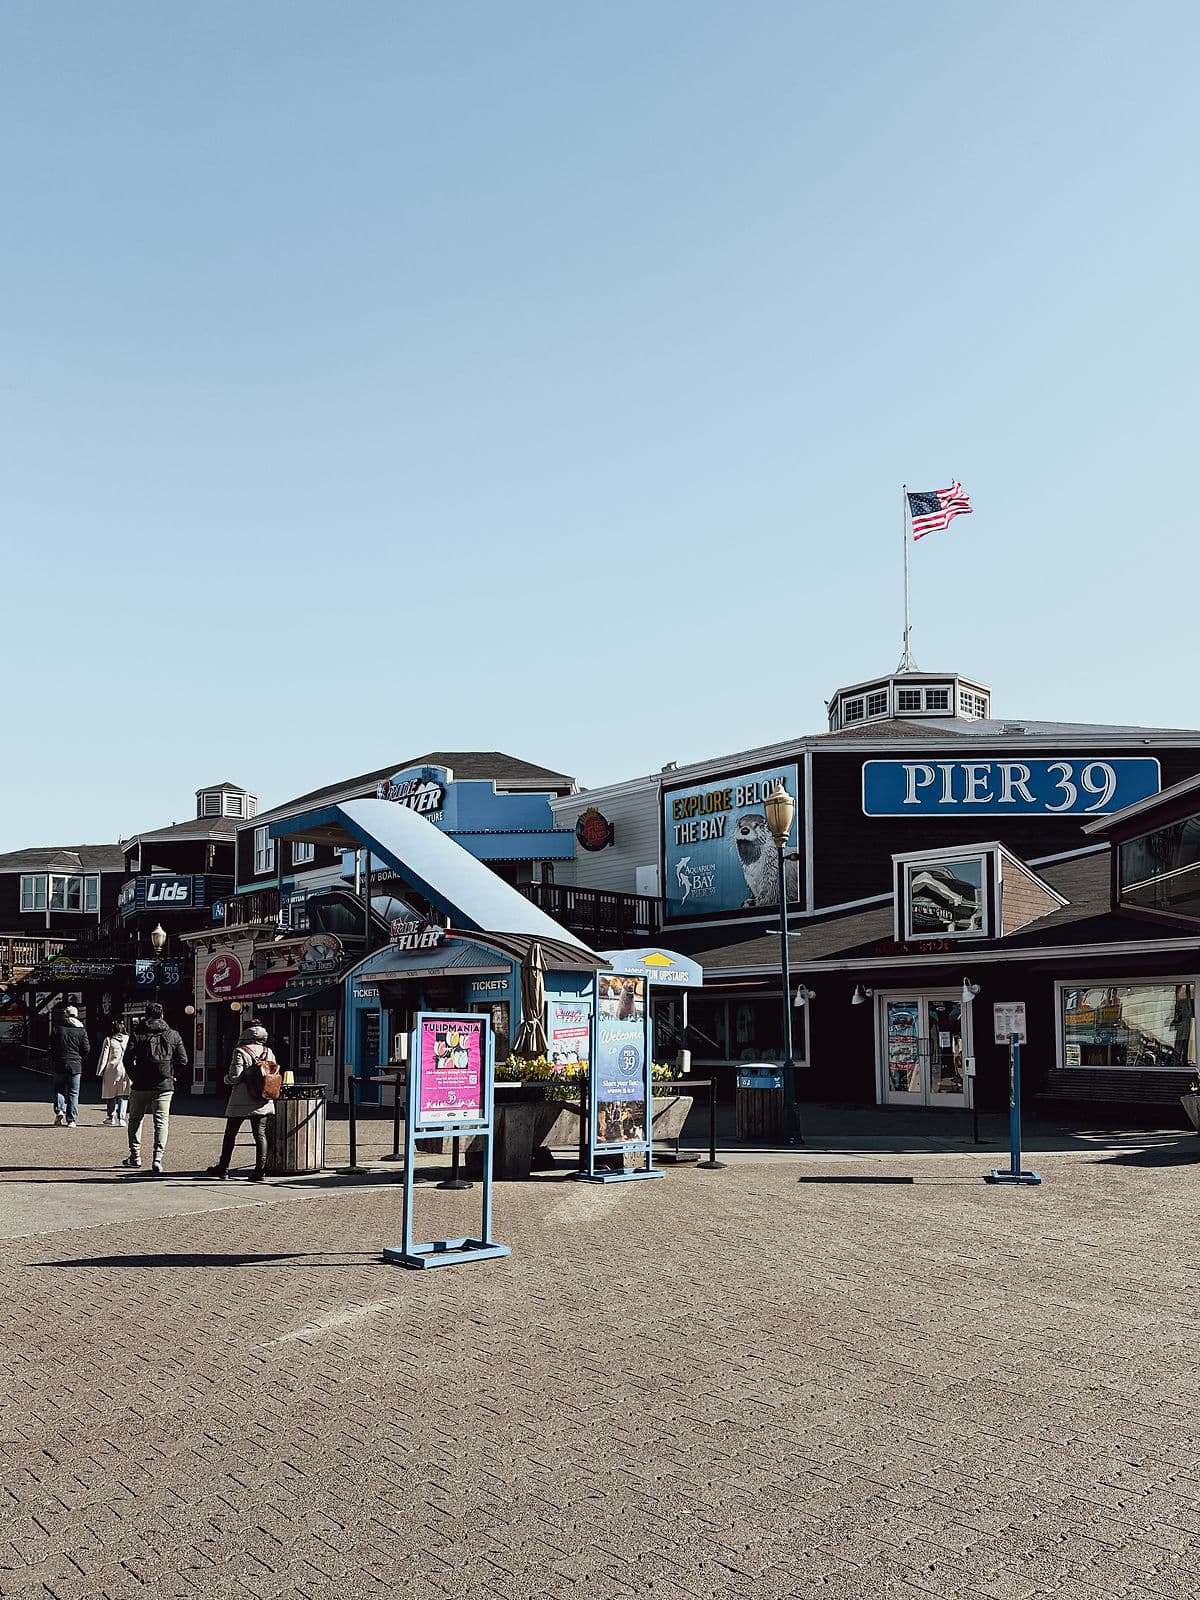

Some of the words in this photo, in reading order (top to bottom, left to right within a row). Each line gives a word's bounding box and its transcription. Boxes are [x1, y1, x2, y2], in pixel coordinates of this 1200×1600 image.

[902, 763, 1037, 804] PIER
[1045, 762, 1117, 812] 39
[672, 789, 732, 820] EXPLORE
[674, 822, 698, 845] THE
[700, 815, 726, 841] BAY
[685, 864, 716, 876] AQUARIUM
[692, 875, 715, 889] BAY
[147, 882, 188, 902] Lids
[399, 932, 440, 951] FLYER
[138, 971, 155, 984] 39
[163, 972, 180, 985] 39
[660, 970, 689, 982] UPSTAIRS
[472, 980, 508, 991] TICKETS
[424, 1023, 480, 1032] TULIPMANIA
[623, 1056, 635, 1071] 39
[447, 1094, 457, 1104] 39
